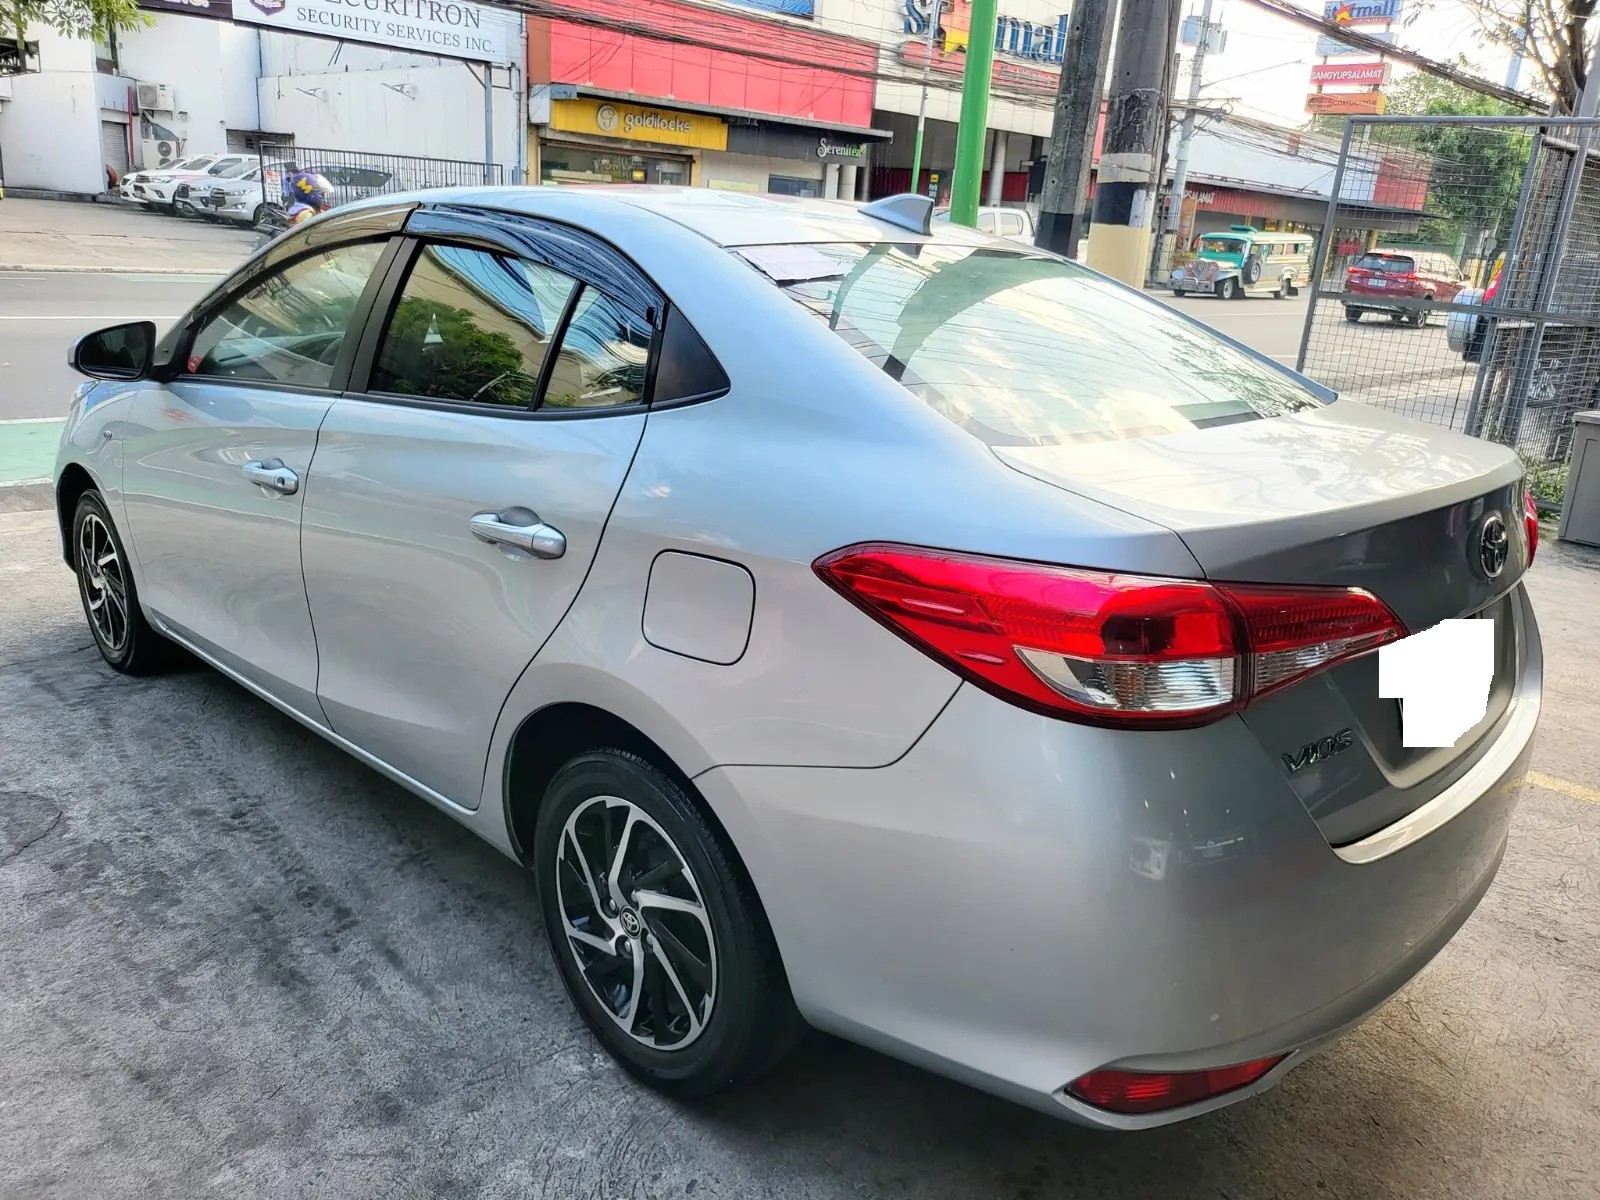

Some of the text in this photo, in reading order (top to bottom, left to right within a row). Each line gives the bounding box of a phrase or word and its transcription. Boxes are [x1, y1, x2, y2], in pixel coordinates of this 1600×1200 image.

[297, 7, 496, 54] SECURITY SERVICES INC.
[1311, 69, 1383, 80] SAMGYUPSALAMAT
[624, 112, 691, 133] goldilocks
[817, 137, 862, 158] Serenitea
[1281, 727, 1353, 773] VIOS
